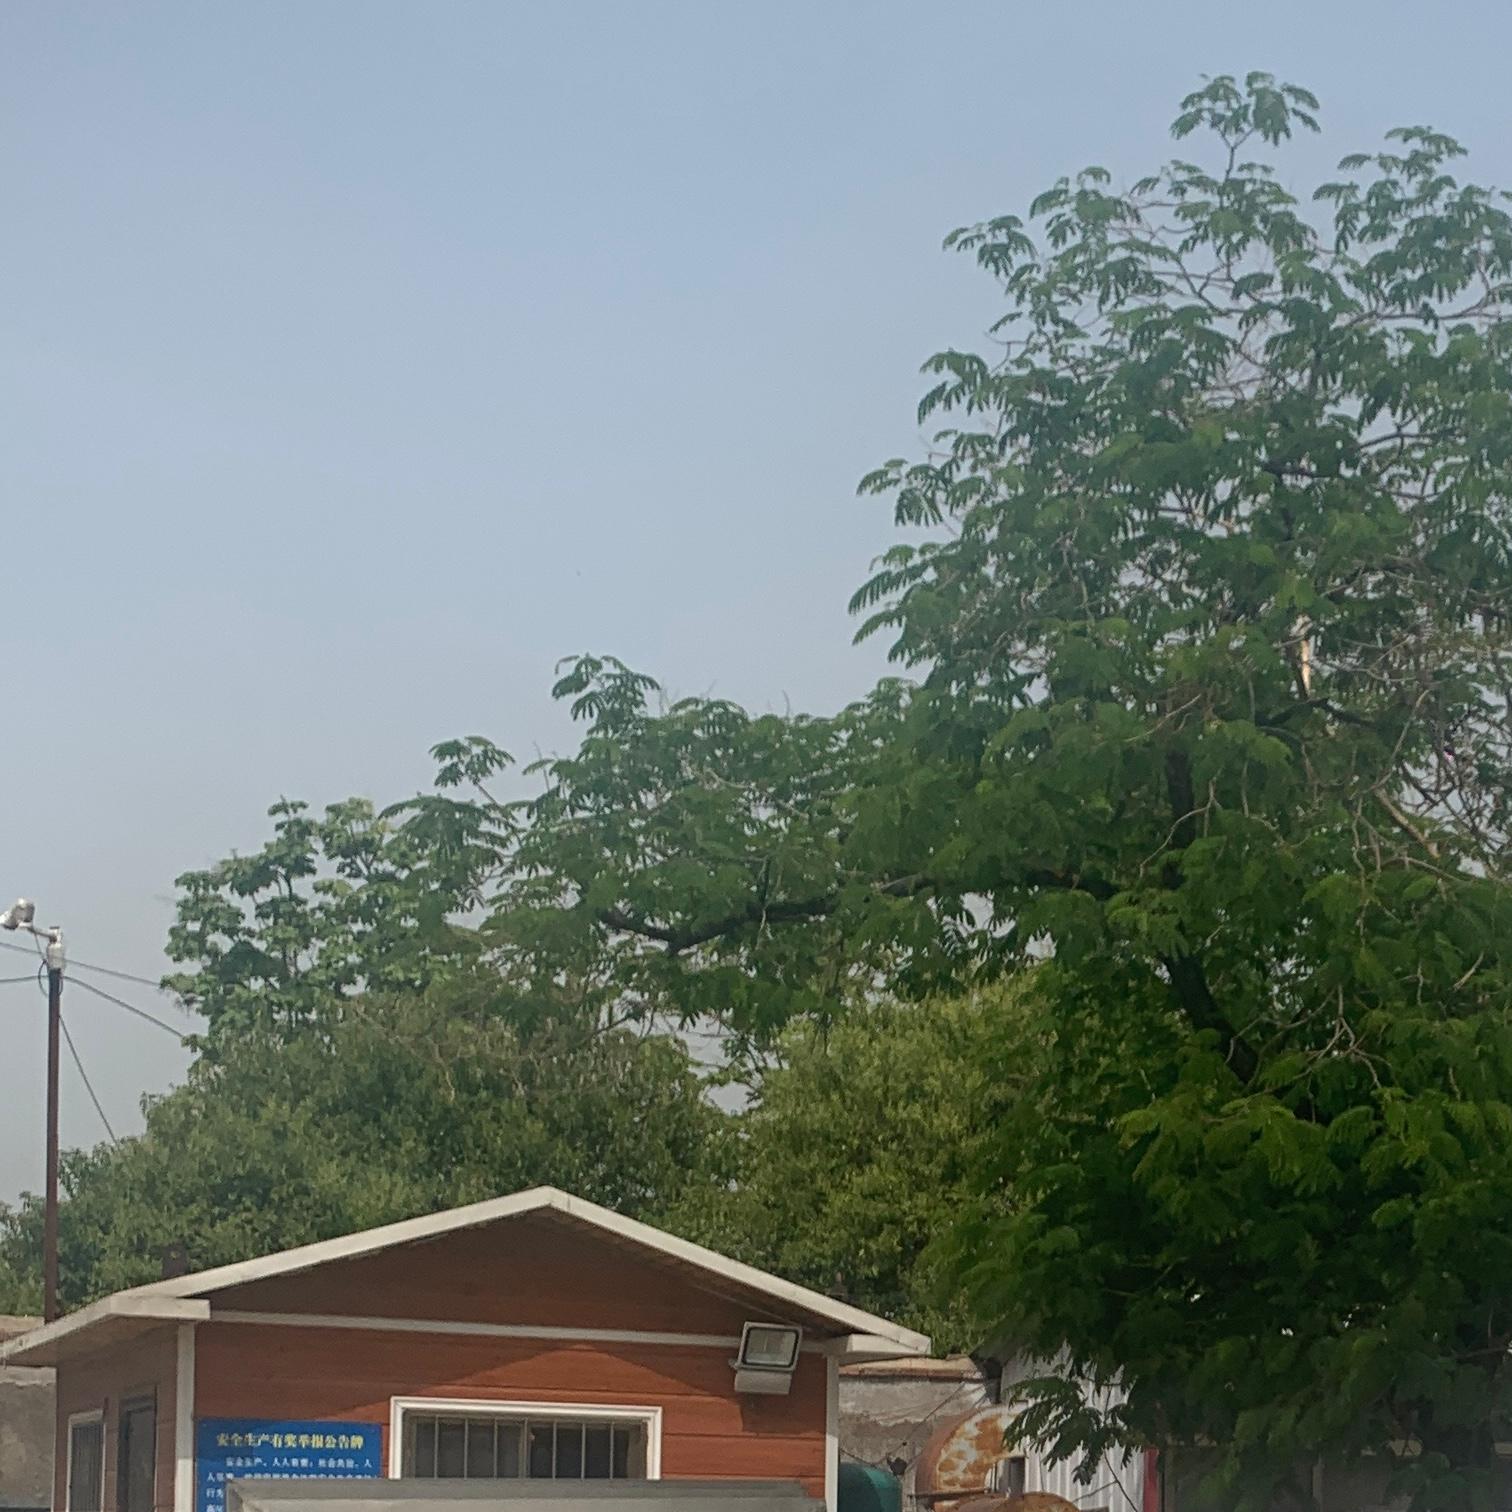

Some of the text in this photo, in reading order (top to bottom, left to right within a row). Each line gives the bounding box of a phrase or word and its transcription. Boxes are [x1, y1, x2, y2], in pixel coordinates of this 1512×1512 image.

[217, 1433, 364, 1449] 安全生产有奖举报公告牌
